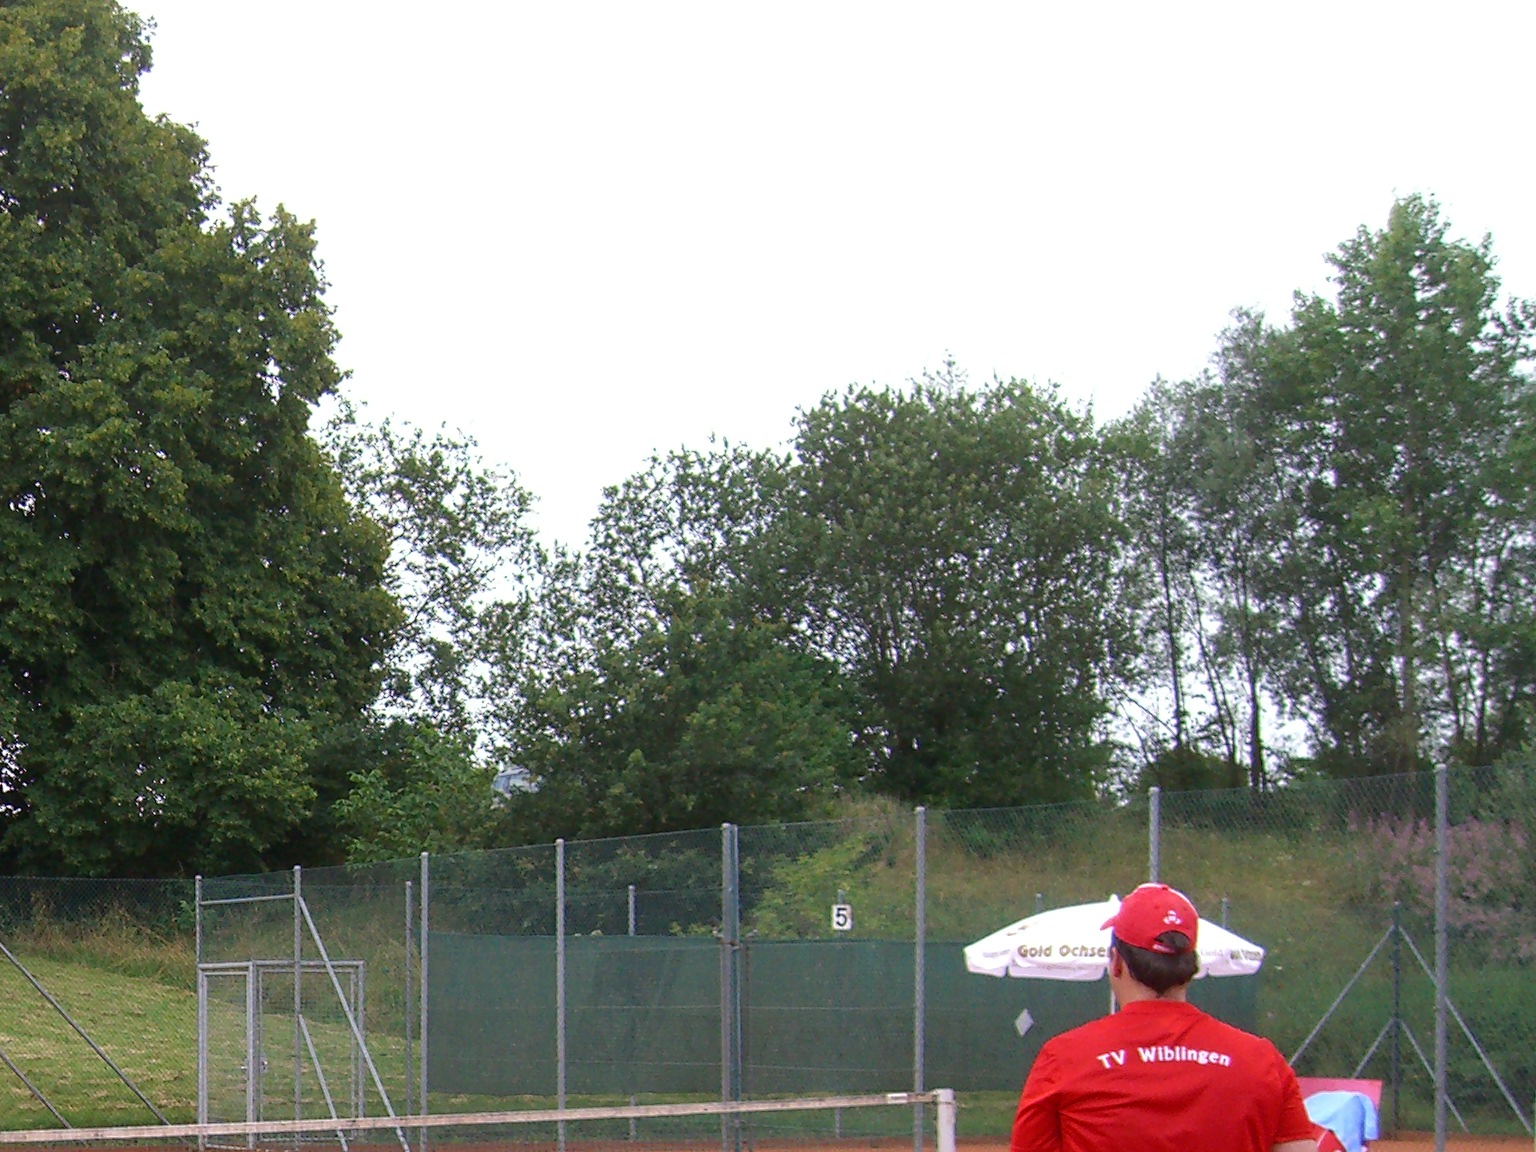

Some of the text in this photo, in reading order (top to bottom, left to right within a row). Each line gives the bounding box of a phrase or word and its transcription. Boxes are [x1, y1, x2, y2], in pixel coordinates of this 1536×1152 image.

[836, 907, 848, 927] 5
[1017, 944, 1052, 958] Gold
[1097, 1046, 1231, 1069] TV Wiblingen
